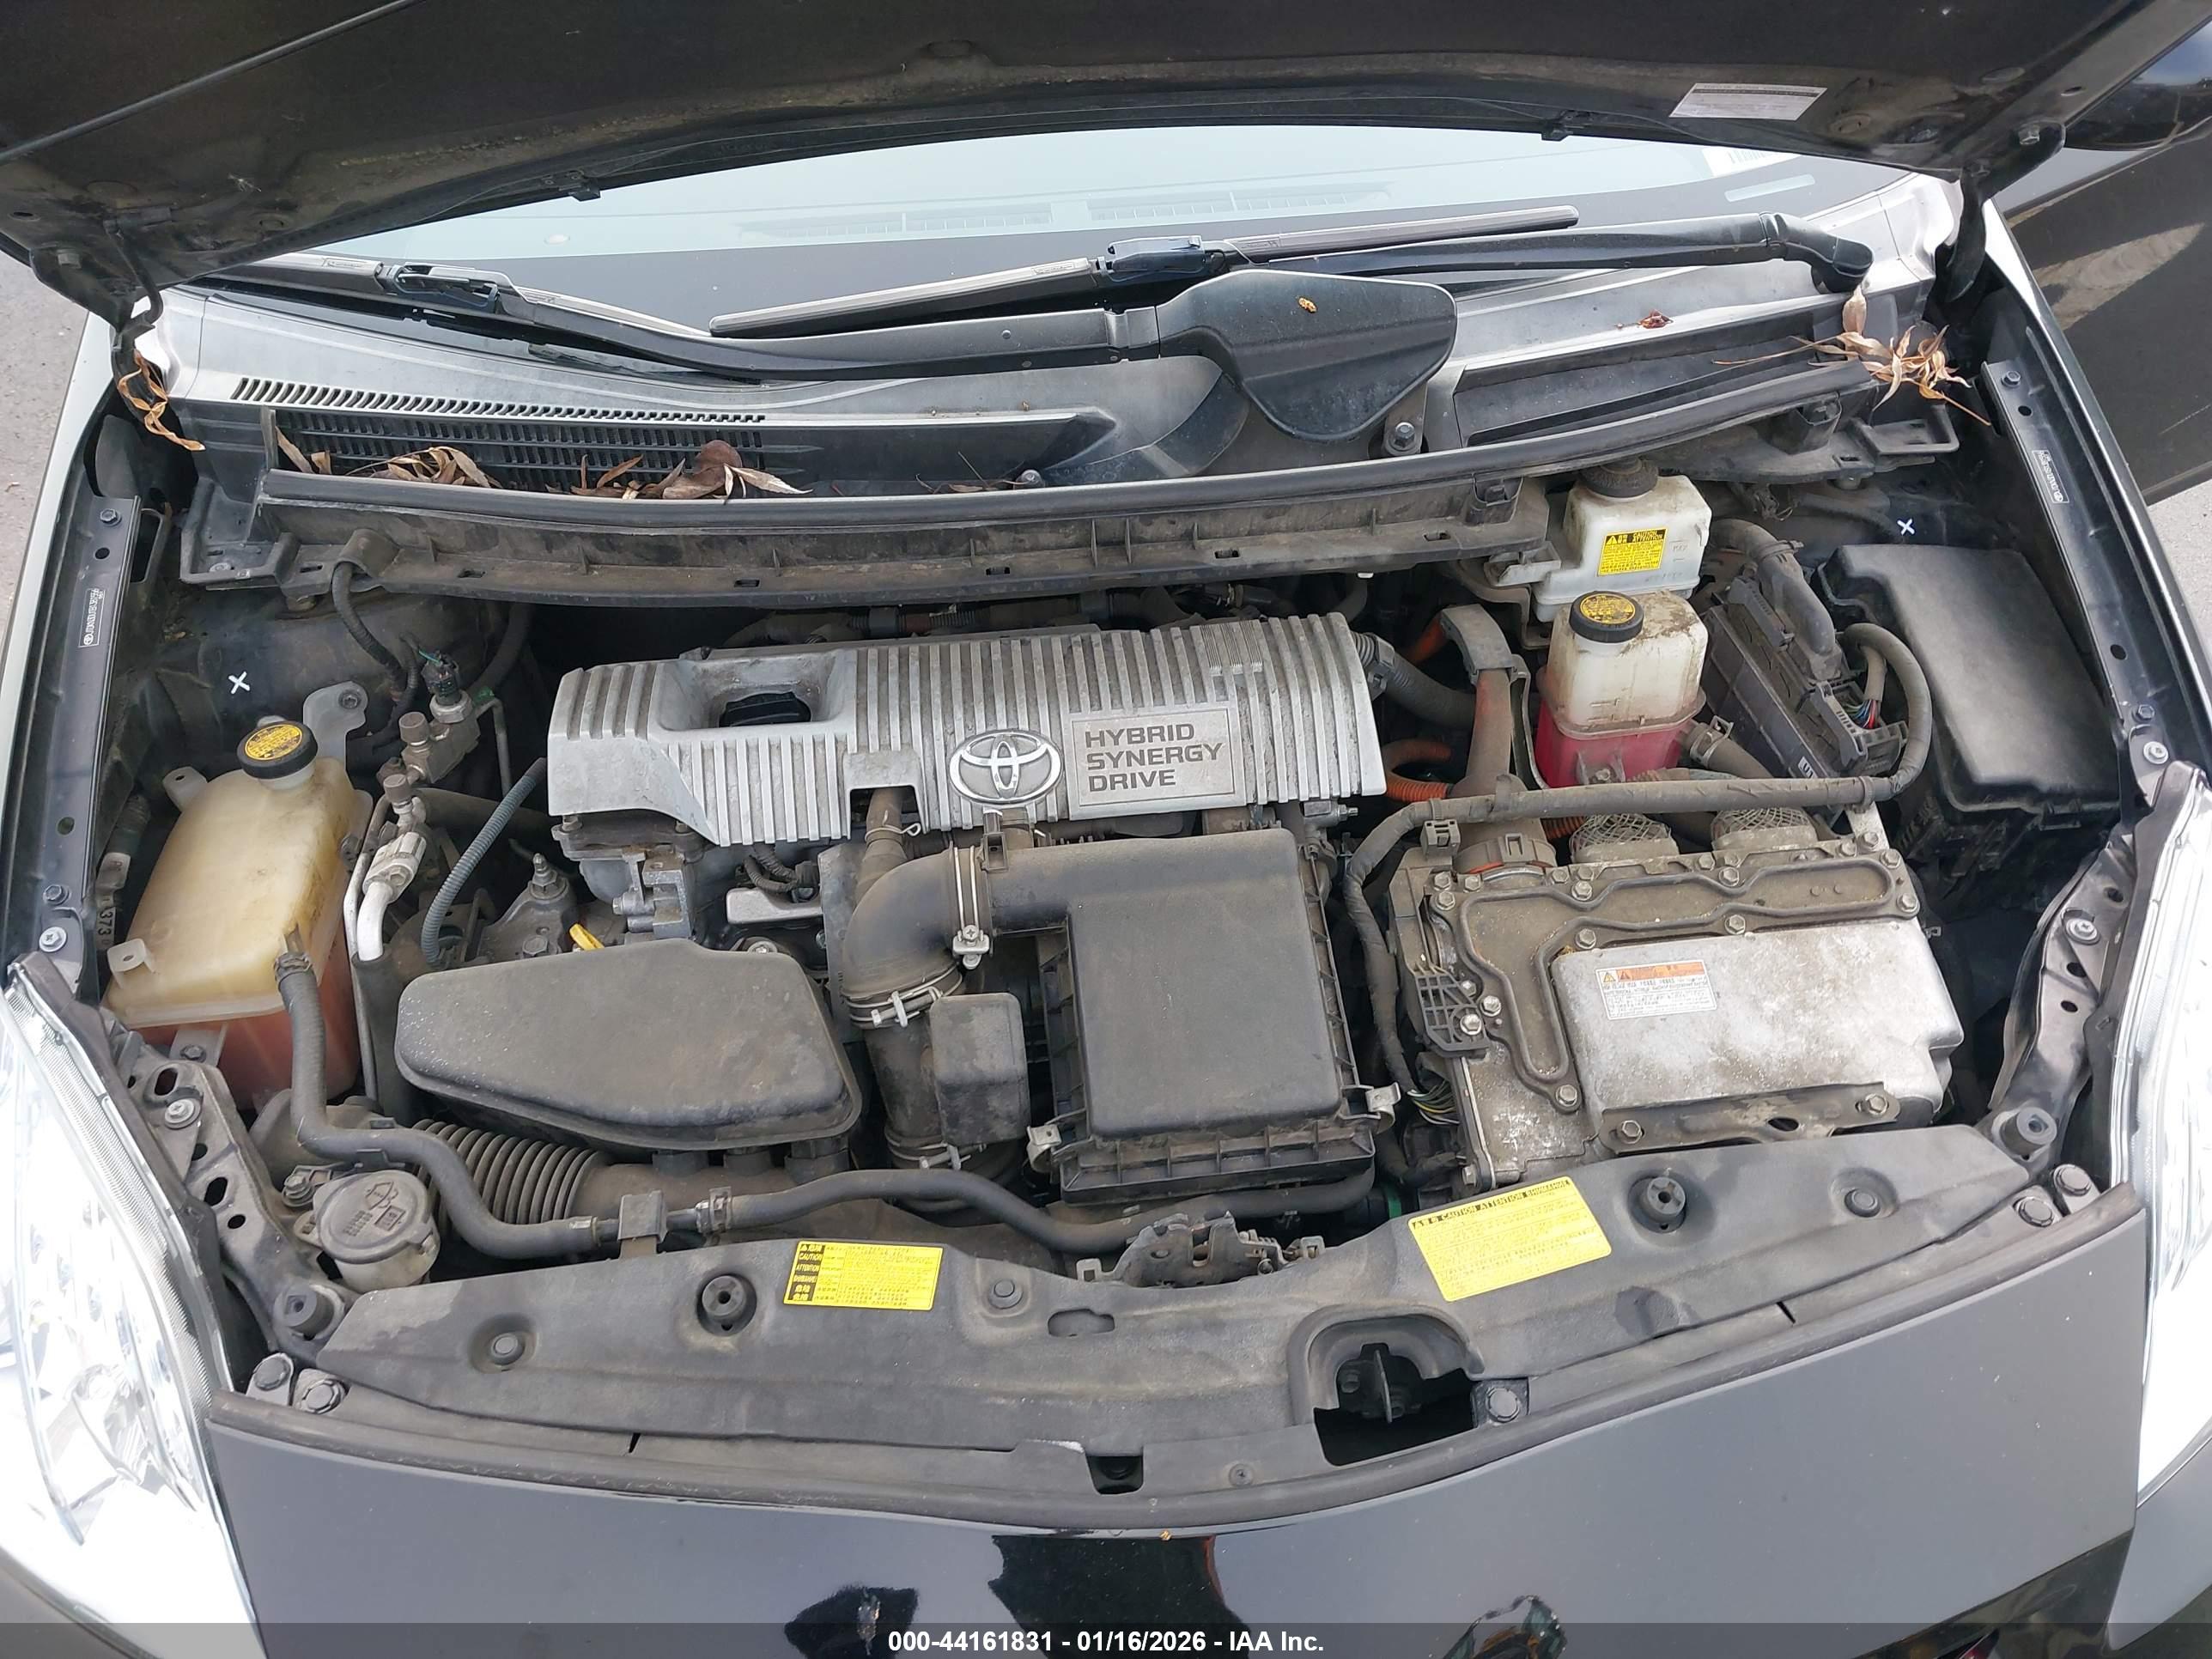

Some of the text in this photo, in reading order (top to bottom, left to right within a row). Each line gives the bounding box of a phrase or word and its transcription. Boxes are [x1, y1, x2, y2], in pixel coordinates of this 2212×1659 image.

[1085, 724, 1194, 748] HYBRID
[1086, 743, 1223, 770] SYNERGY
[1088, 769, 1176, 793] DRIVE
